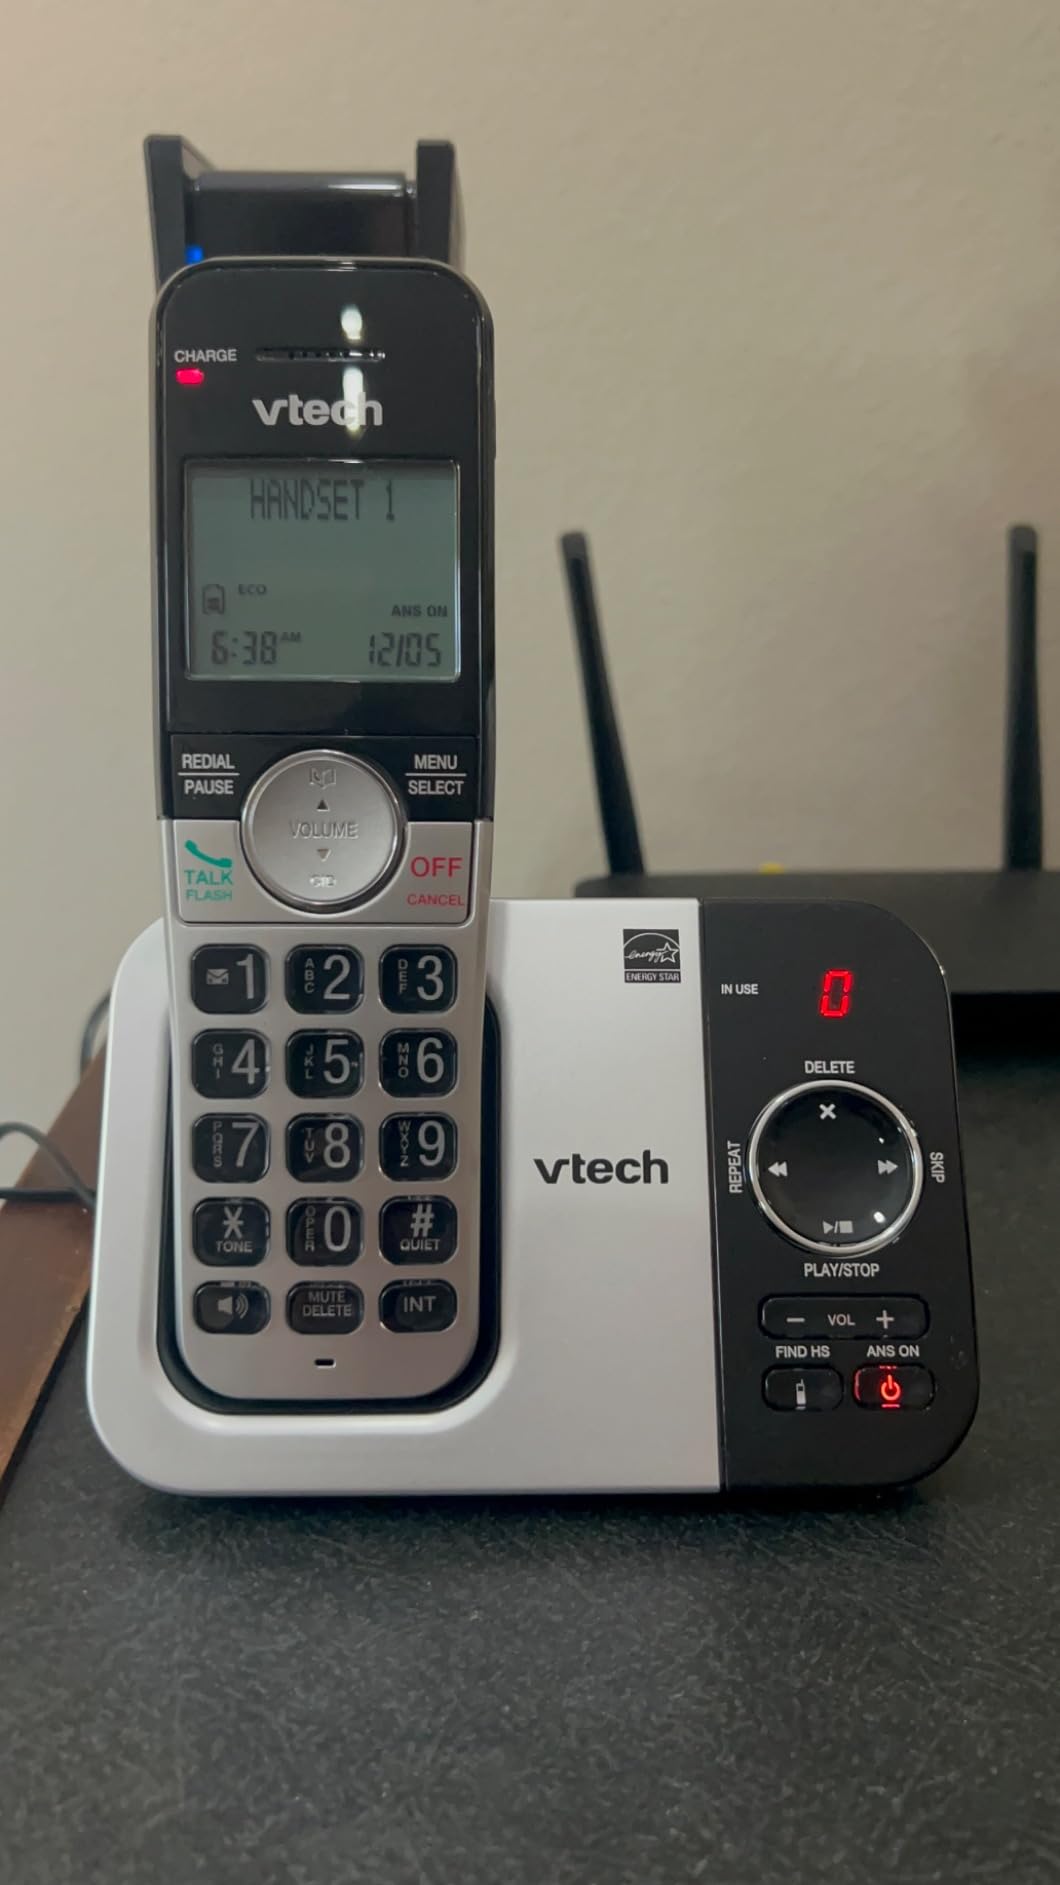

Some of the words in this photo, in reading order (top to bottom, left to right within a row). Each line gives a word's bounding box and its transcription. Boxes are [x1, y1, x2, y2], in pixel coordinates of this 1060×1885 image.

[174, 348, 238, 362] CHARGE
[251, 393, 384, 427] vtech
[249, 479, 365, 521] HANDSET
[385, 479, 396, 521] 1
[238, 583, 267, 596] ECO
[391, 604, 422, 617] ANS
[426, 604, 448, 617] ON
[210, 630, 278, 666] 6:38
[280, 631, 303, 644] AM
[368, 632, 443, 667] 12/05
[181, 753, 235, 770] REDIAL
[414, 754, 458, 770] MENU
[184, 779, 234, 795] PAUSE
[408, 779, 465, 795] SELECT
[290, 821, 360, 840] VOLUME
[411, 856, 462, 878] OFF
[184, 869, 233, 885] TALK
[185, 889, 233, 901] FLASH
[407, 893, 465, 906] CANCEL
[236, 953, 255, 1000] 1
[323, 954, 351, 1000] 2
[416, 954, 445, 1001] 3
[625, 972, 657, 981] ENERGY
[658, 972, 680, 981] STAR
[720, 983, 733, 995] IN
[735, 983, 759, 995] USE
[819, 969, 853, 1017] 0
[231, 1039, 261, 1085] 4
[323, 1038, 351, 1084] 5
[416, 1037, 445, 1084] 6
[804, 1060, 856, 1075] DELETE
[231, 1121, 261, 1168] 7
[323, 1122, 351, 1169] 8
[417, 1120, 446, 1167] 9
[533, 1149, 670, 1185] vtech
[728, 1140, 742, 1193] REPEAT
[929, 1151, 945, 1183] SKIP
[323, 1205, 352, 1252] 0
[215, 1240, 253, 1253] TONE
[399, 1239, 441, 1252] QUIET
[803, 1262, 881, 1279] PLAY/STOP
[308, 1290, 346, 1304] MUTE
[403, 1295, 437, 1313] INT
[302, 1304, 353, 1318] DELETE
[827, 1314, 855, 1326] VOL
[775, 1345, 807, 1359] FIND
[810, 1345, 831, 1359] HS
[866, 1345, 896, 1358] ANS
[898, 1345, 919, 1358] ON
